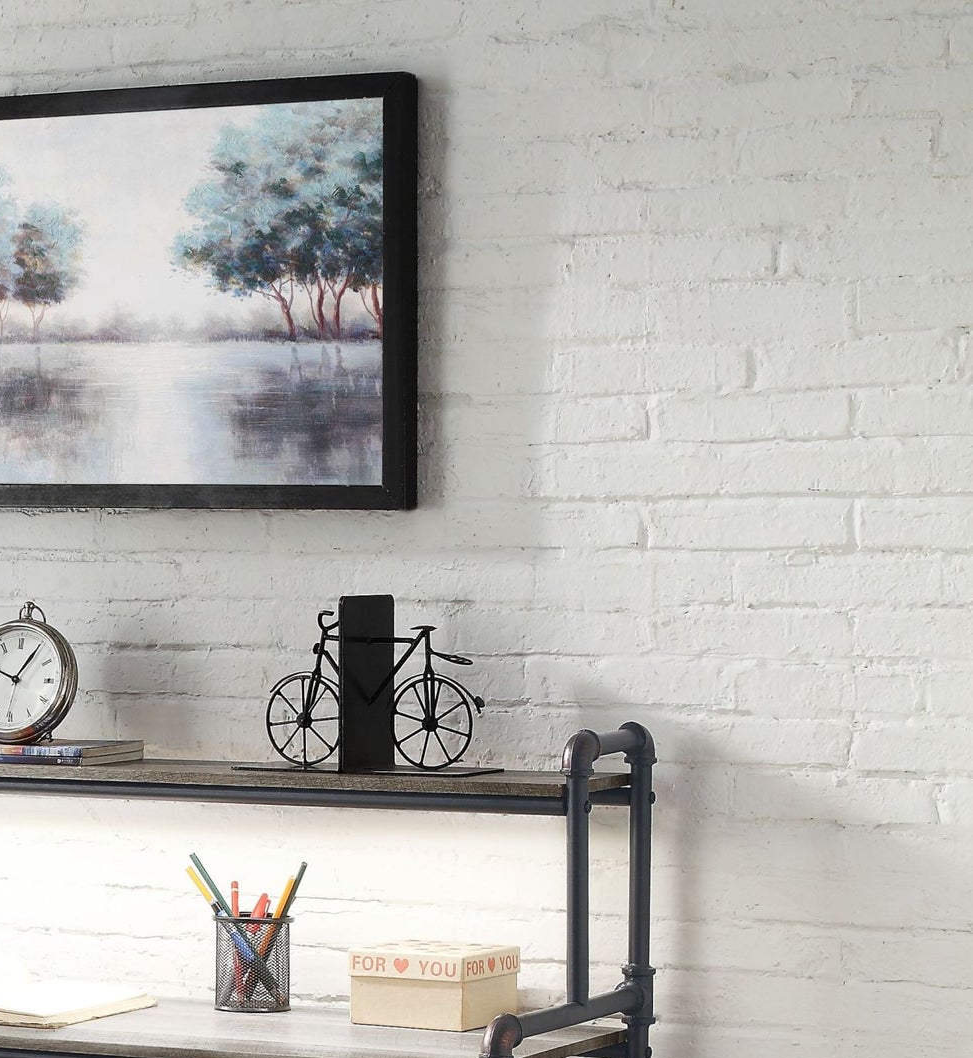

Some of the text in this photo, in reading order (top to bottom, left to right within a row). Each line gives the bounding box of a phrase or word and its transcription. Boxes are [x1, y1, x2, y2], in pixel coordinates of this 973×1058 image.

[352, 954, 457, 978] FOR YOU
[466, 954, 519, 977] FOR YOU
